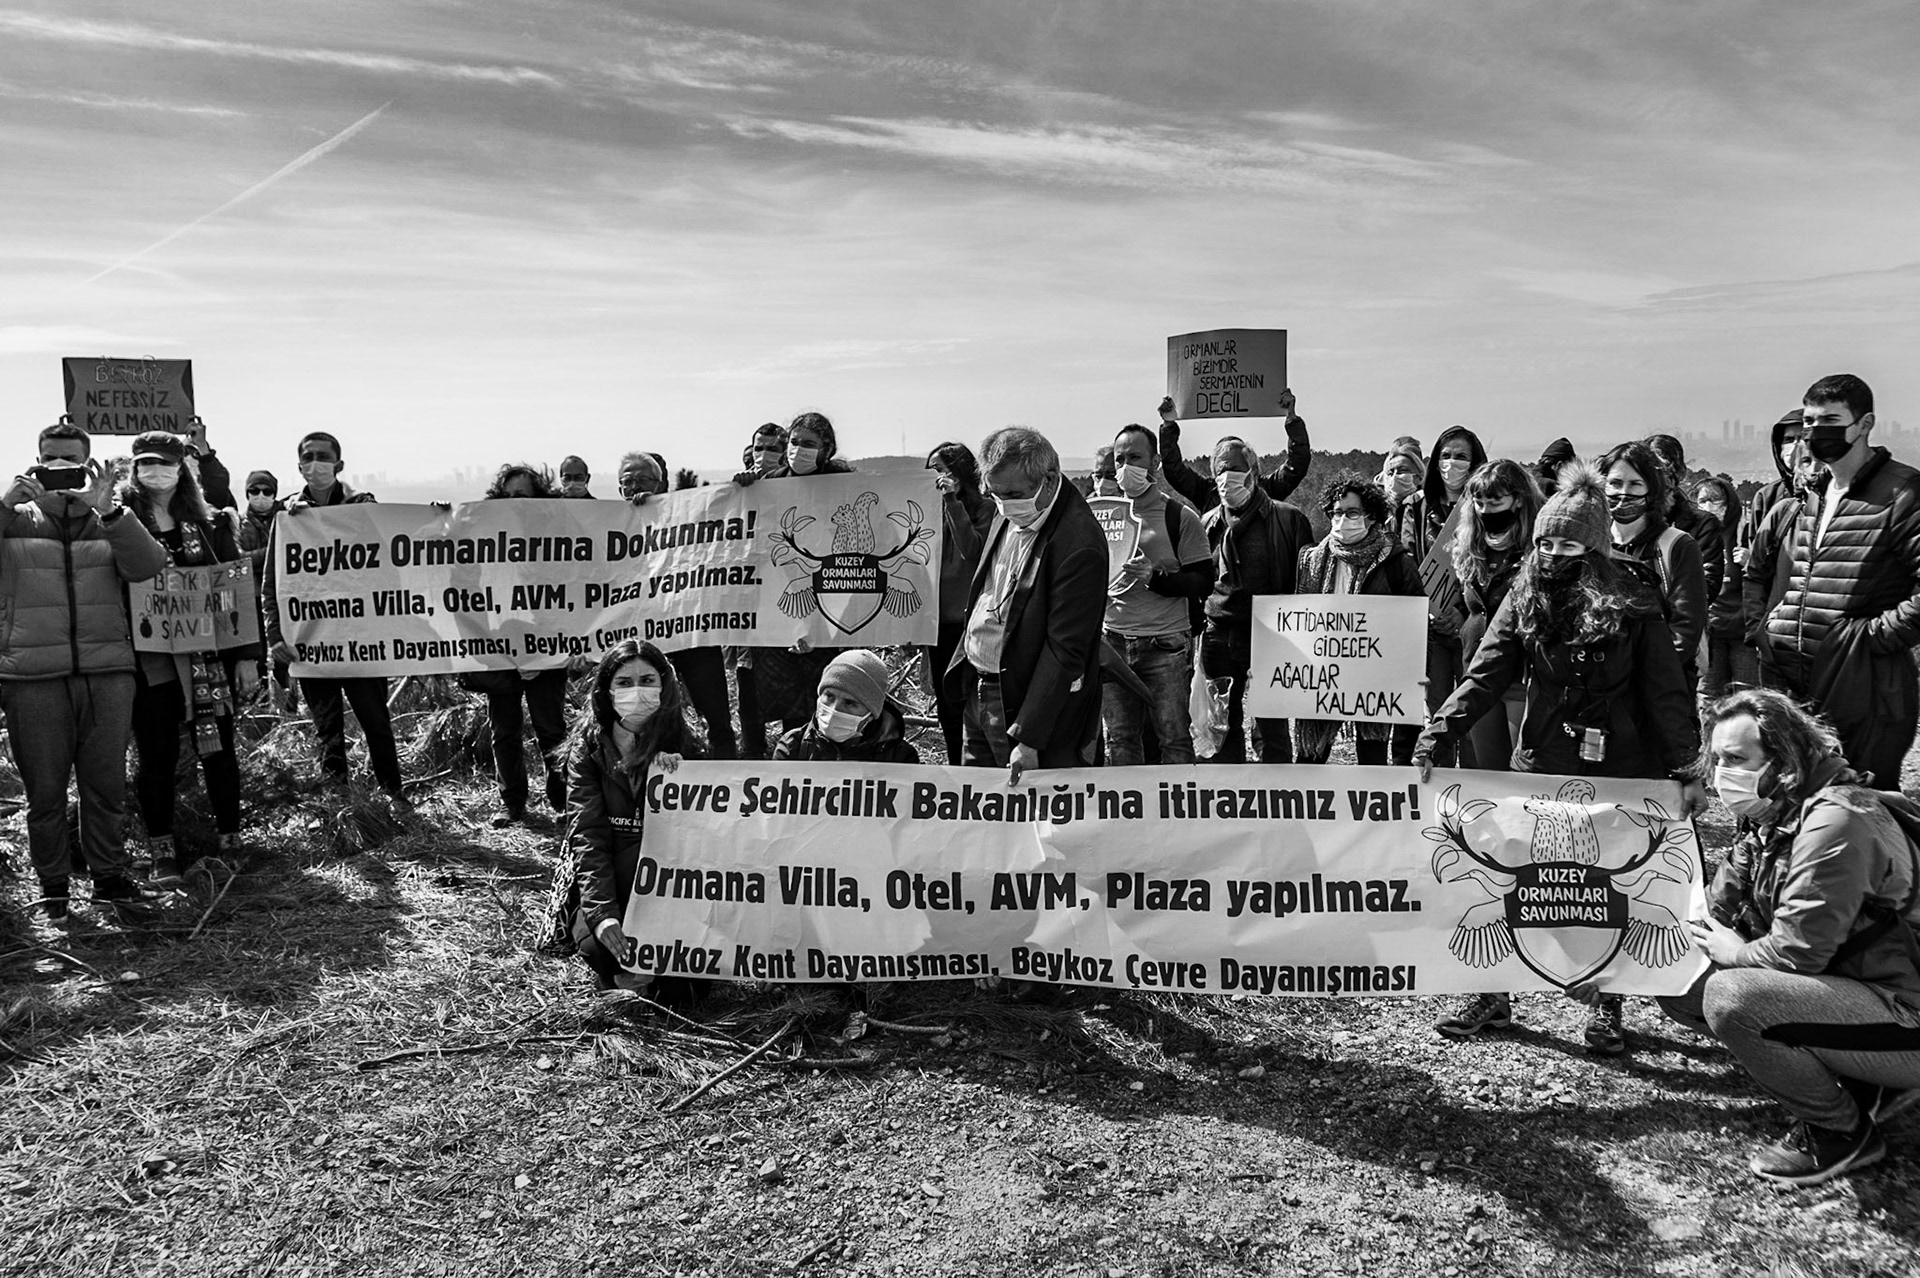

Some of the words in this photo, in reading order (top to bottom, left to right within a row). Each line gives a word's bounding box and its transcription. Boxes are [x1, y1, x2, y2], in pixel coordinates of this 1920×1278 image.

[1184, 340, 1237, 359] ORMANLAR
[1200, 373, 1264, 390] SERMAYENİN
[86, 387, 170, 408] NEFESSİZ
[1196, 391, 1249, 414] DEĞİL
[87, 412, 179, 431] KALMASIN
[285, 538, 380, 575] Beykoz
[391, 531, 593, 567] Ormanlarına
[606, 511, 758, 561] Dokunma!
[821, 567, 877, 578] ORMANLARI
[835, 556, 866, 567] KUZEY
[153, 569, 226, 592] BEYKOZ
[822, 579, 876, 590] SAVUNMASI
[288, 595, 365, 622] Ormana
[372, 589, 434, 617] Villa,
[443, 586, 502, 614] Otel,
[510, 584, 575, 612] AVM,
[585, 581, 641, 609] Plaza
[648, 564, 763, 600] yapılmaz.
[1277, 606, 1368, 633] İKTİDARINIZ
[295, 641, 345, 665] Beykoz
[349, 640, 386, 662] Kent
[393, 636, 518, 660] Dayanışması,
[525, 632, 592, 657] Beykoz
[596, 626, 638, 652] Çevre
[645, 612, 758, 640] Dayanışması
[1313, 635, 1383, 659] GİDECEK
[1269, 661, 1341, 694] AĞAÇLAR
[1315, 690, 1405, 718] KALACAK
[647, 774, 731, 813] Çevre
[739, 777, 898, 818] Şehircilik
[1158, 781, 1337, 820] itirazımız
[1347, 784, 1422, 822] var!
[633, 856, 766, 904] Ormana
[778, 865, 871, 913] Villa,
[885, 869, 975, 915] Otel,
[990, 872, 1090, 911] AVM,
[1106, 872, 1211, 911] Plaza
[1226, 873, 1422, 918] yapılmaz.
[1538, 868, 1587, 884] KUZEY
[1518, 886, 1608, 904] ORMANLARI
[1520, 906, 1608, 923] SAVUNMASI
[620, 936, 723, 977] Beykoz
[733, 944, 796, 979] Kent
[1011, 947, 1114, 983] Beykoz
[1125, 954, 1207, 989] Çevre
[1220, 957, 1416, 997] Dayanışması
